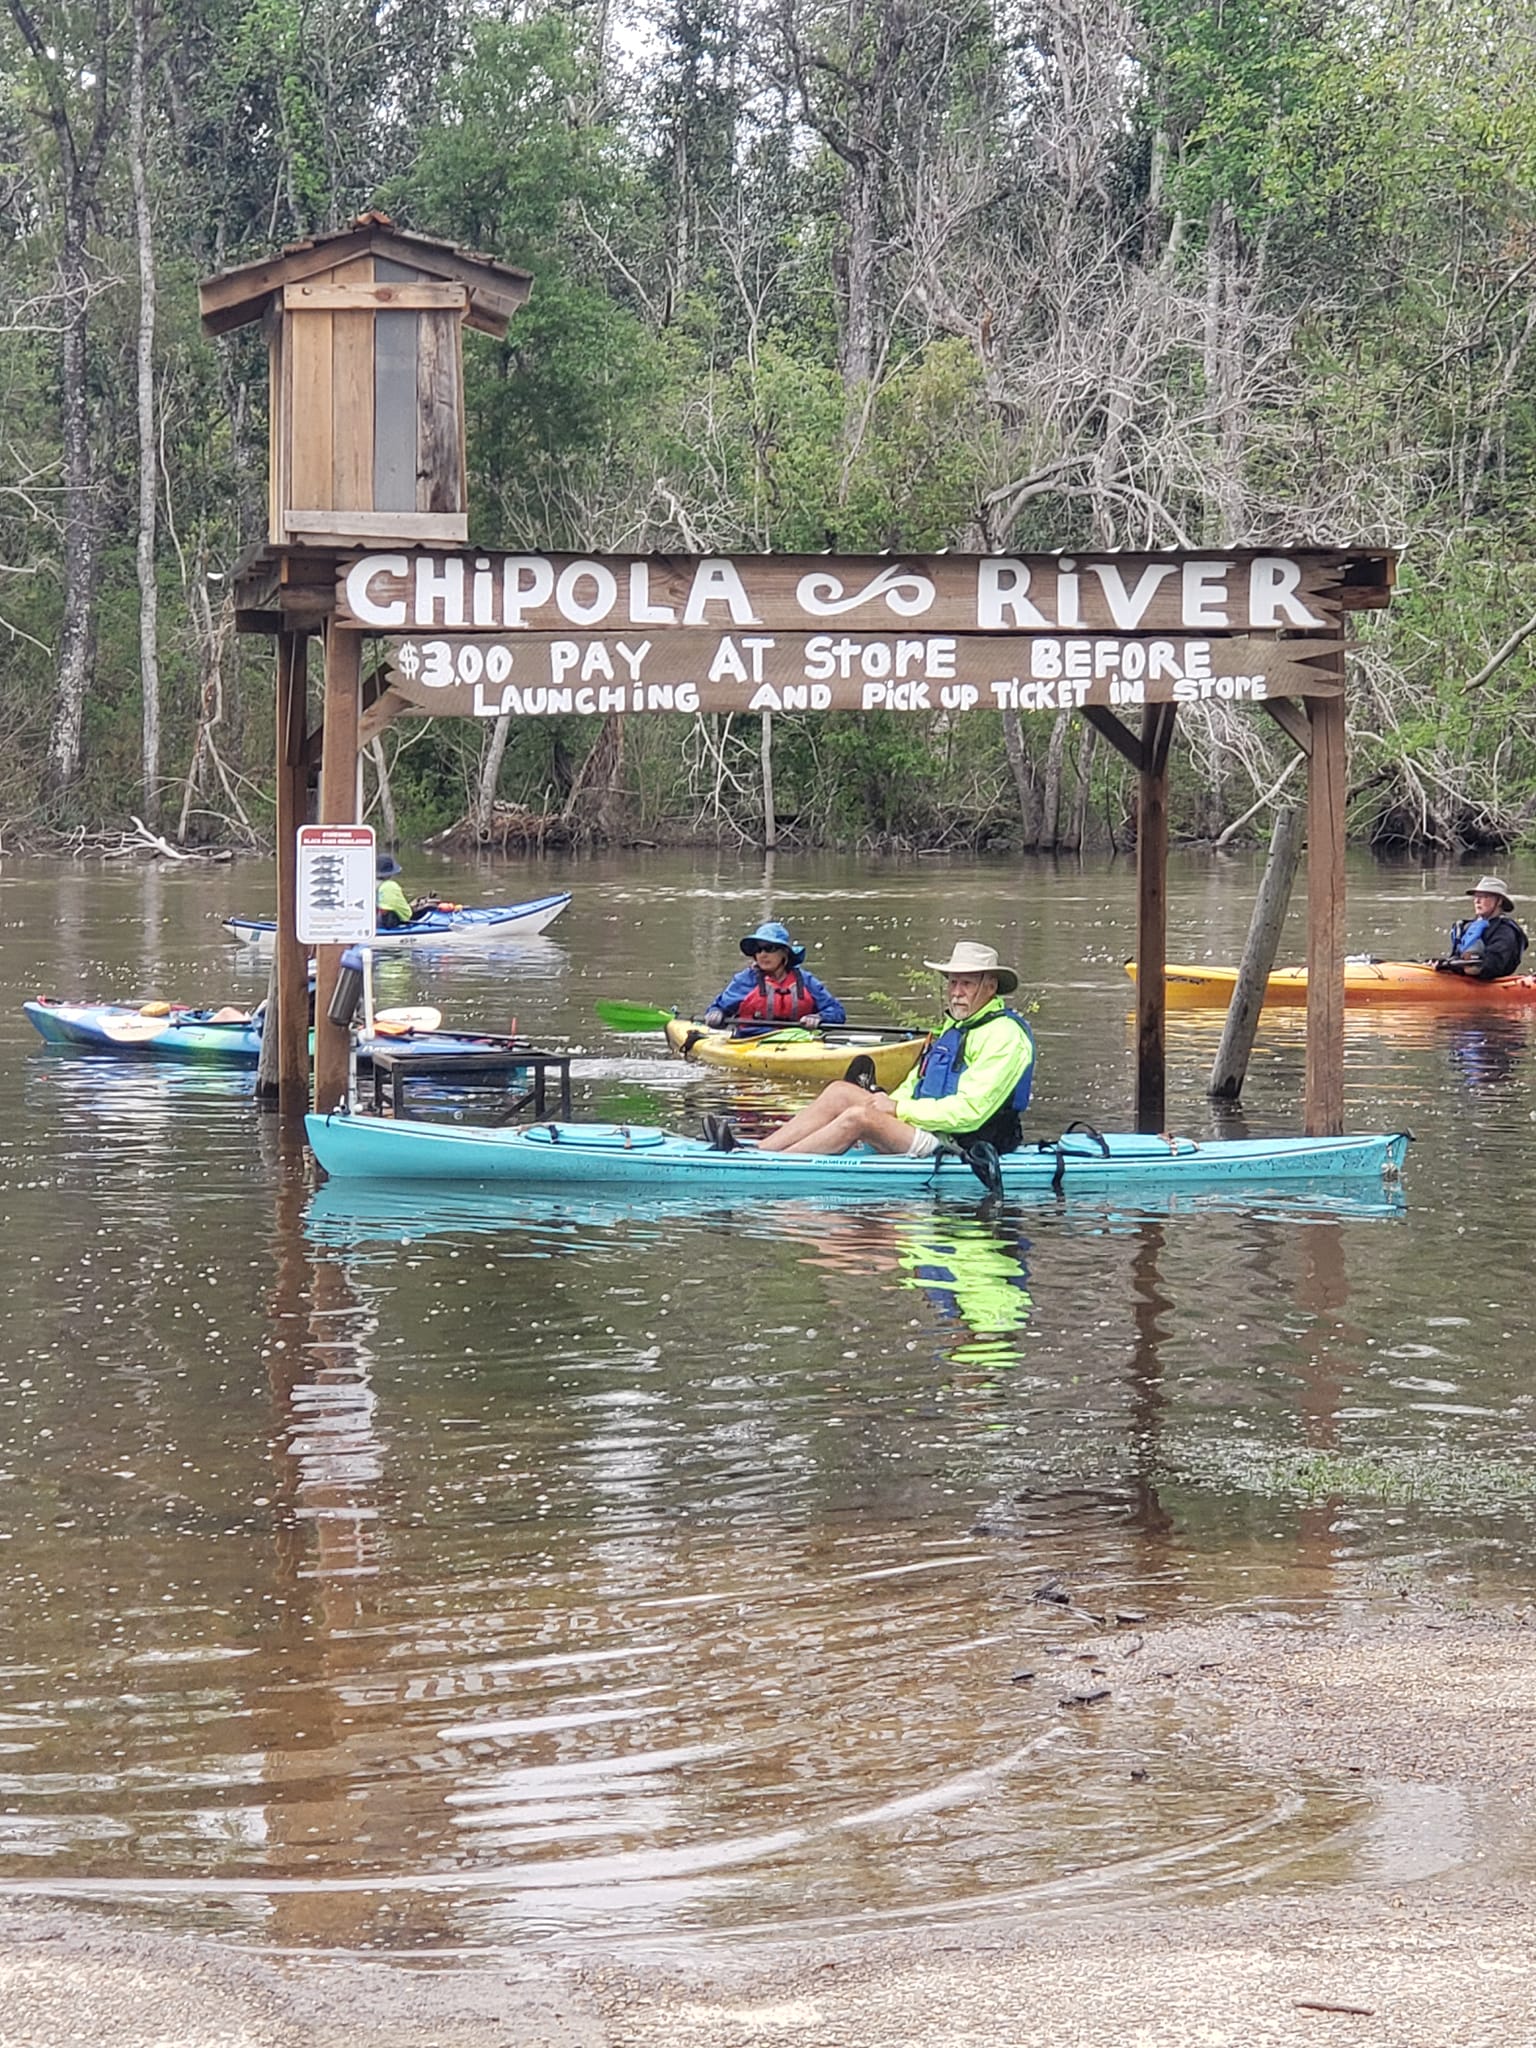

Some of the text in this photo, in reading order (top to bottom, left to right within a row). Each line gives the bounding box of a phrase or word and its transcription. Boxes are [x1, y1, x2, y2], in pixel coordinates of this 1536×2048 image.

[550, 639, 652, 684] PAY
[707, 635, 776, 684] AT
[1030, 639, 1213, 681] BEFORE
[748, 683, 834, 713] AND
